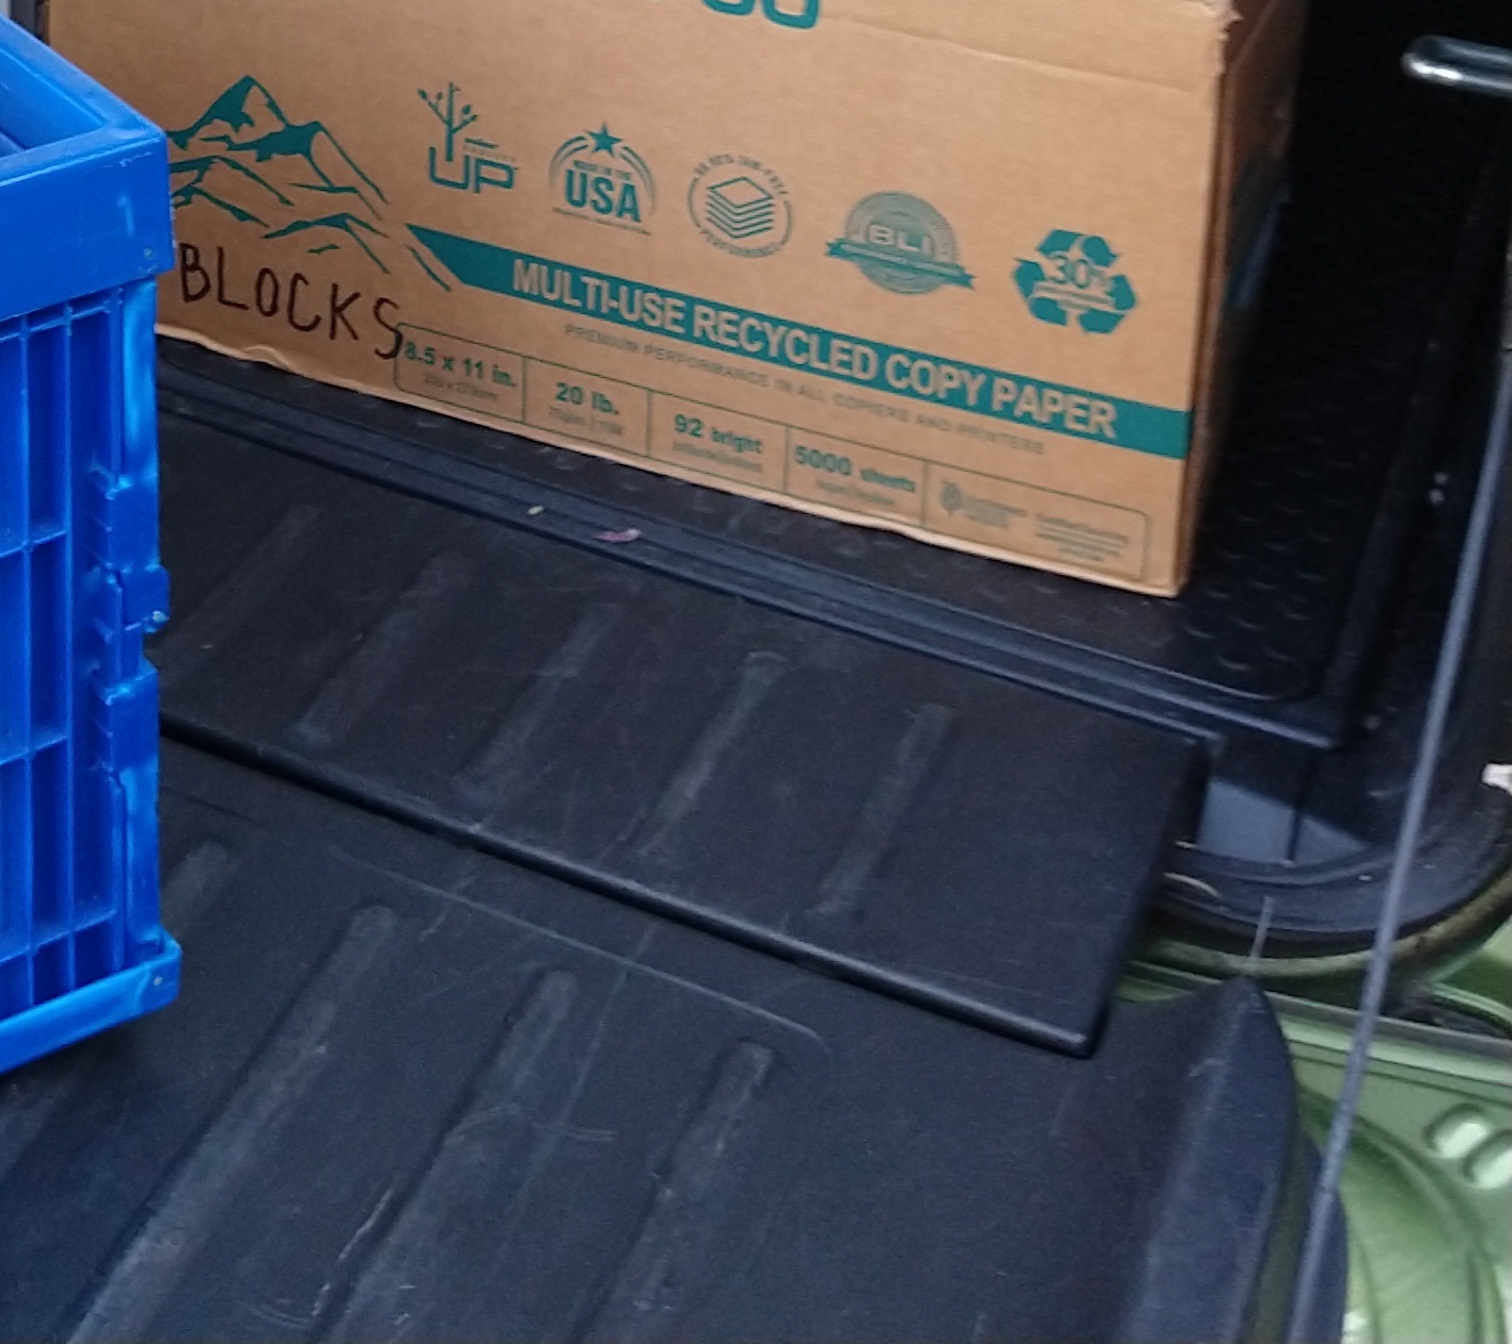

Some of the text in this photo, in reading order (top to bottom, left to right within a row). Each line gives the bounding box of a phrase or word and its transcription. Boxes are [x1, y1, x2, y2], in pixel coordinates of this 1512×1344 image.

[565, 169, 641, 223] USA
[179, 242, 404, 360] BLOCKS
[513, 259, 1117, 439] MULTI-USE RECYCLED COPY PAPER
[442, 356, 454, 371] x
[463, 357, 483, 379] 11
[556, 382, 620, 415] 20 lb.
[674, 414, 703, 438] 92
[794, 445, 853, 476] 5000
